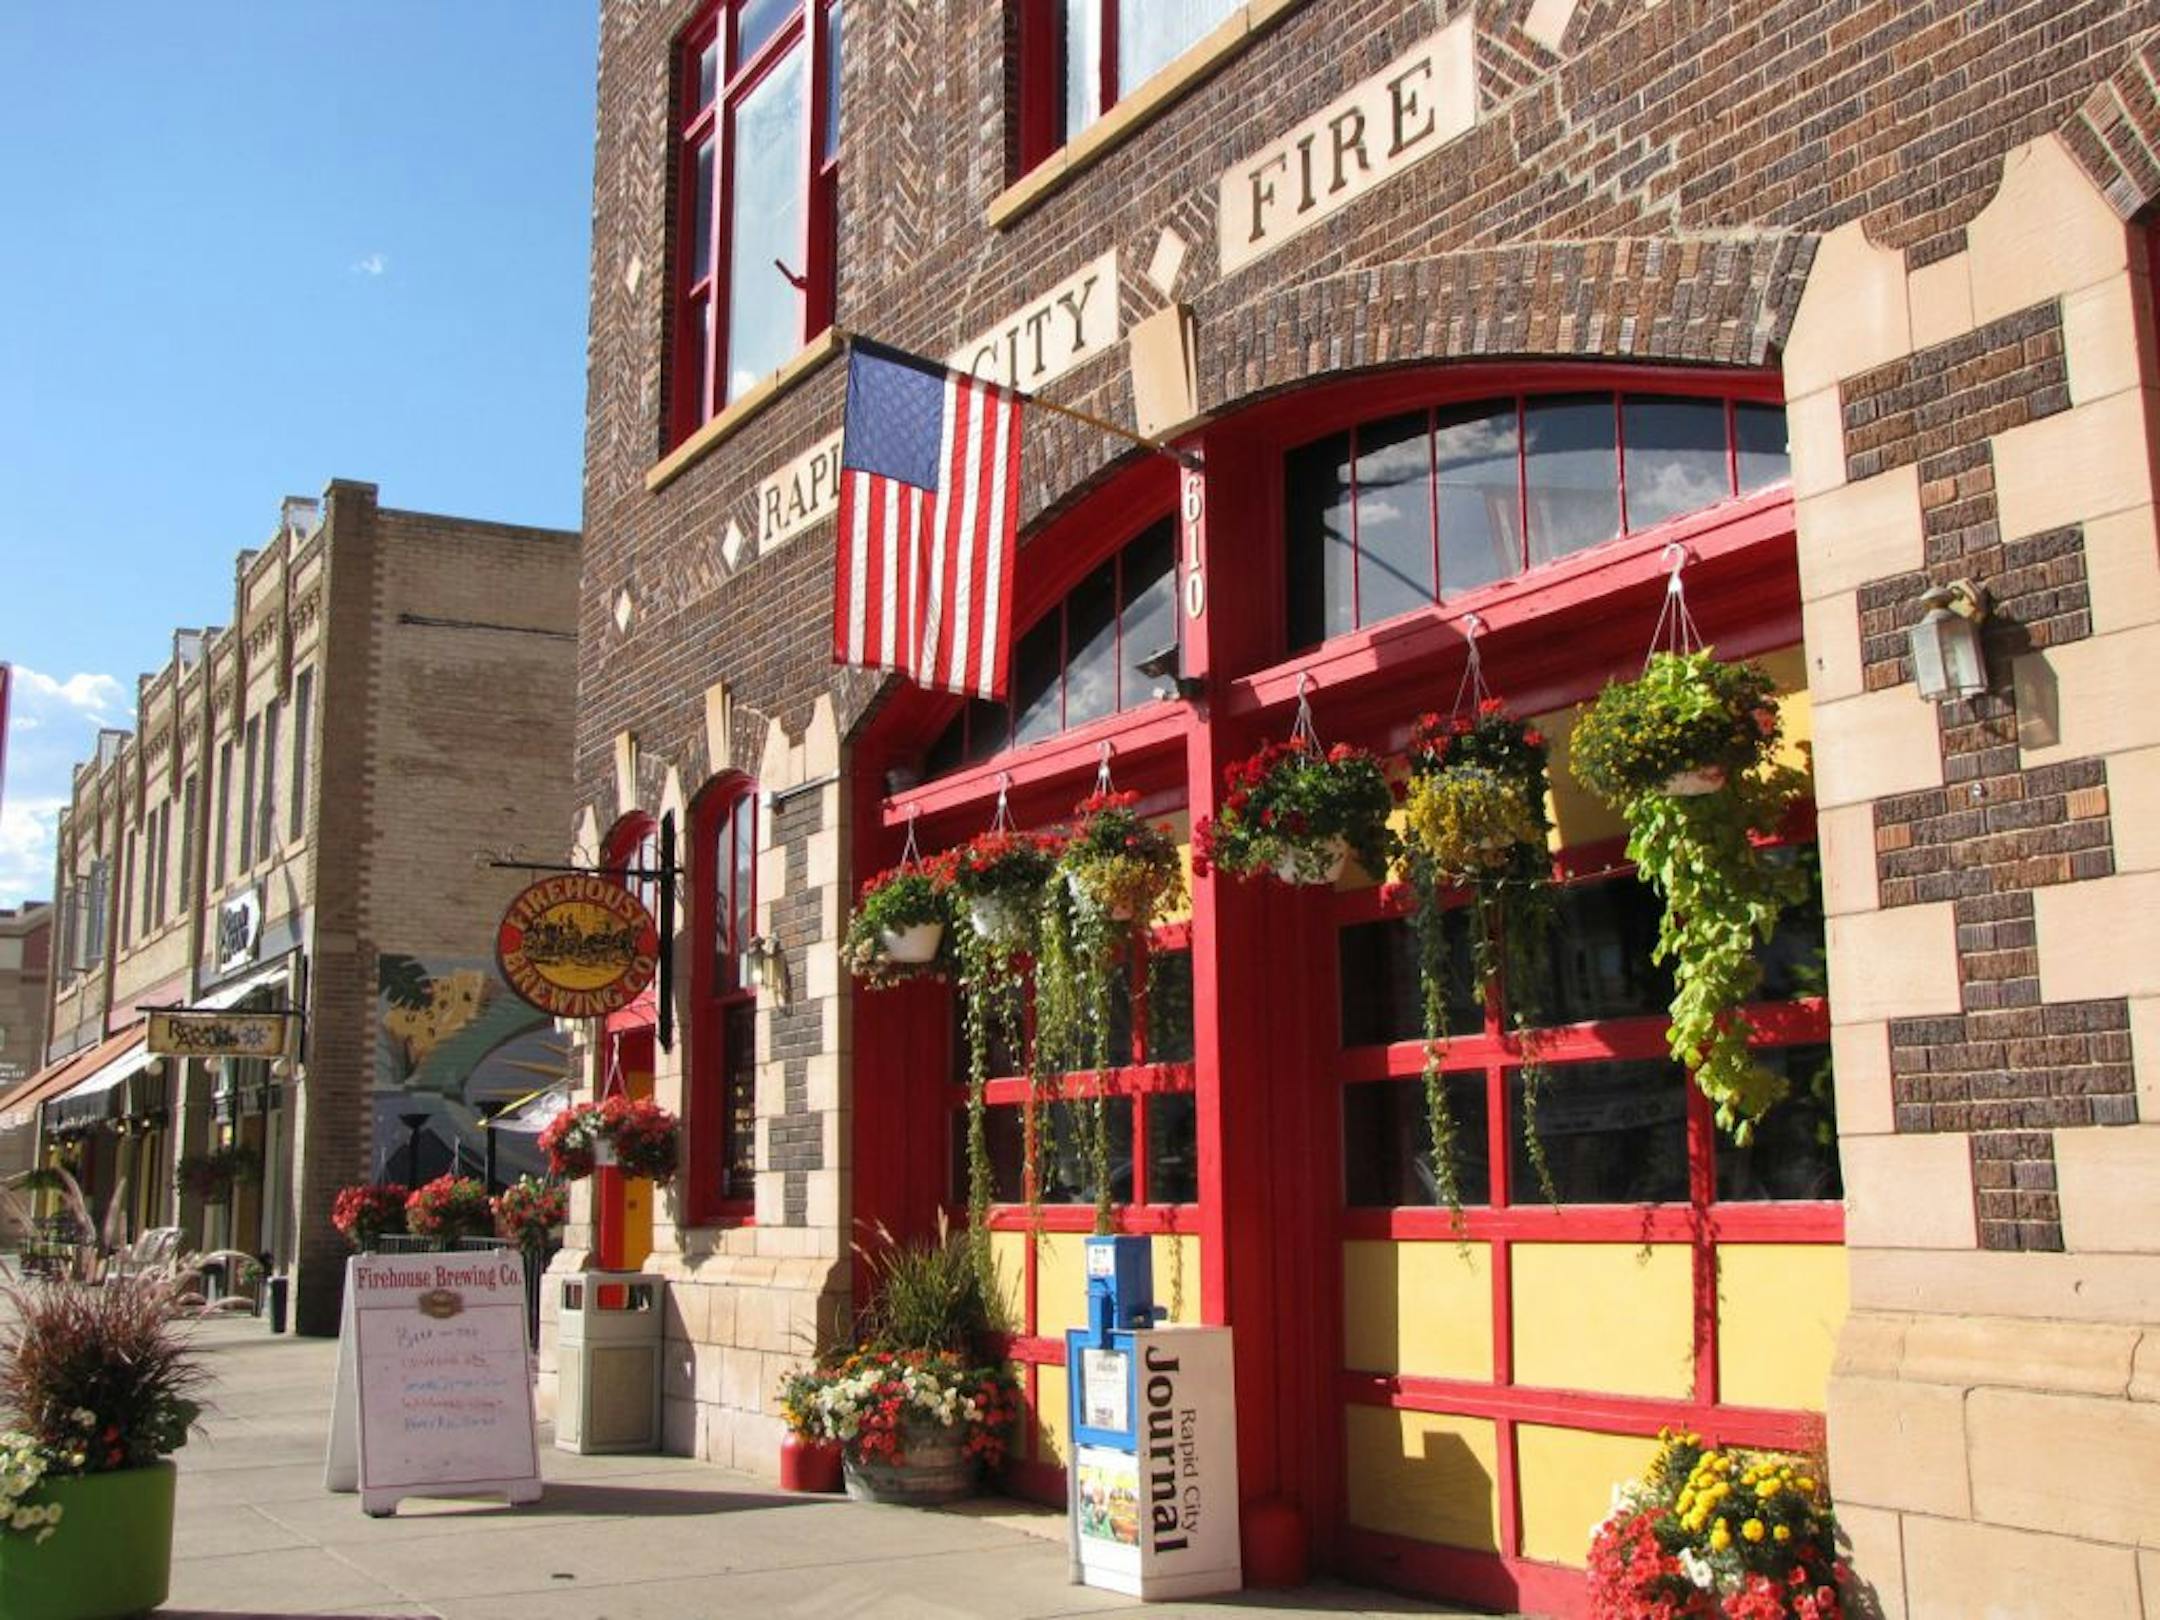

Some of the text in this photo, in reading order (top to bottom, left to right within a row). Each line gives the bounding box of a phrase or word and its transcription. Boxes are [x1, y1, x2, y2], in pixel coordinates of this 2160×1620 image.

[765, 56, 1435, 541] RAPI CITY FIRE
[1183, 475, 1205, 620] 610
[506, 876, 648, 931] FIREHOUSE
[503, 951, 624, 1016] BREWING
[357, 1262, 522, 1290] Firehouse Brewing Co.
[1144, 1345, 1189, 1556] Journal
[1178, 1409, 1202, 1534] Rapid City
